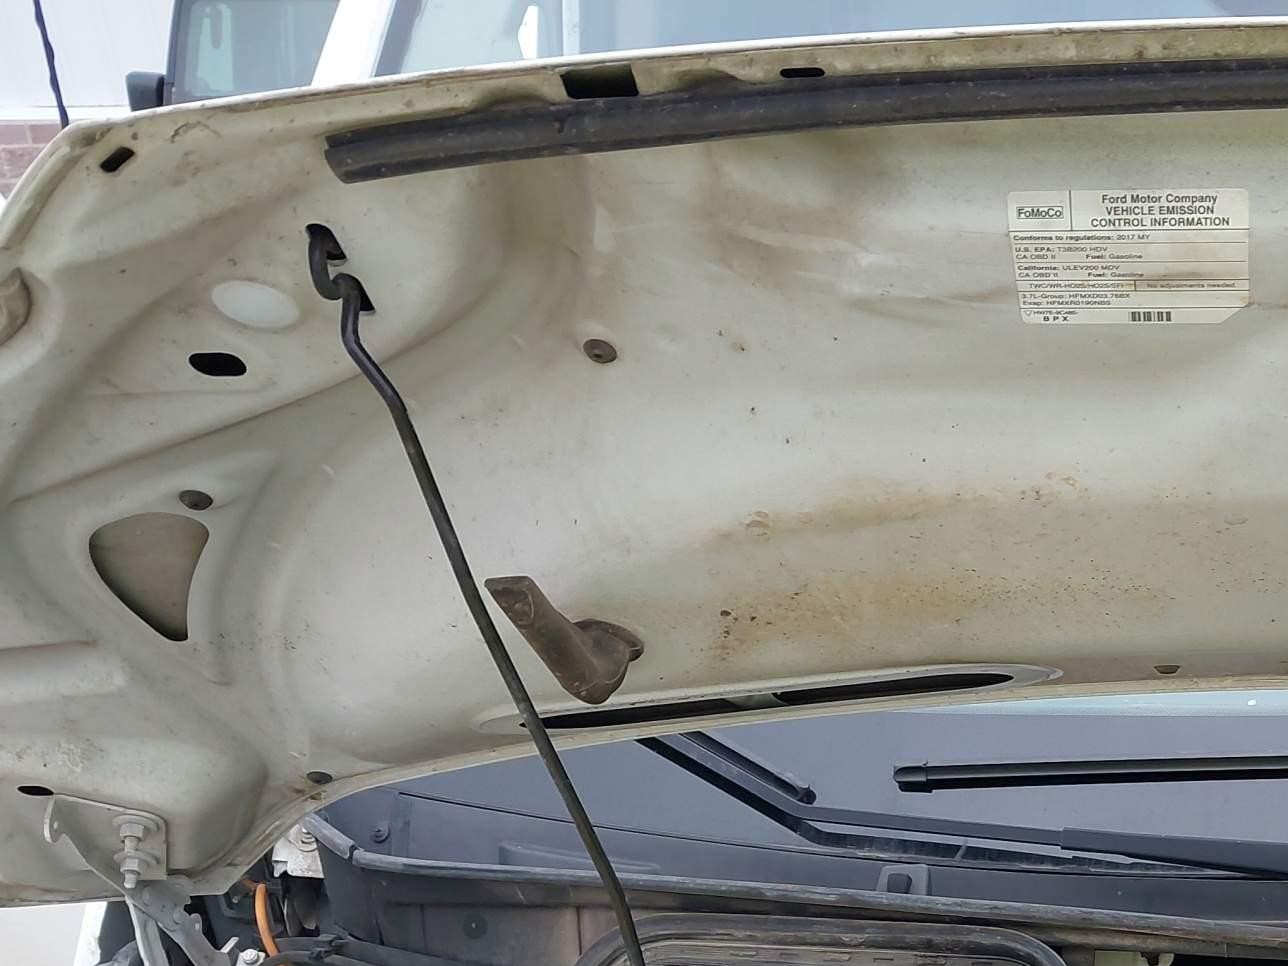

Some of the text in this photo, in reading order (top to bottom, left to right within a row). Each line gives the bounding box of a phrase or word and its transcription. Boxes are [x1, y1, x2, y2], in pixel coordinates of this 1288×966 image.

[1102, 195, 1218, 205] Ford Motor Company
[1017, 207, 1063, 219] FoMoCo
[1105, 206, 1215, 216] VEHICLE EMISSION
[1091, 217, 1230, 228] CONTROL INFORMATION
